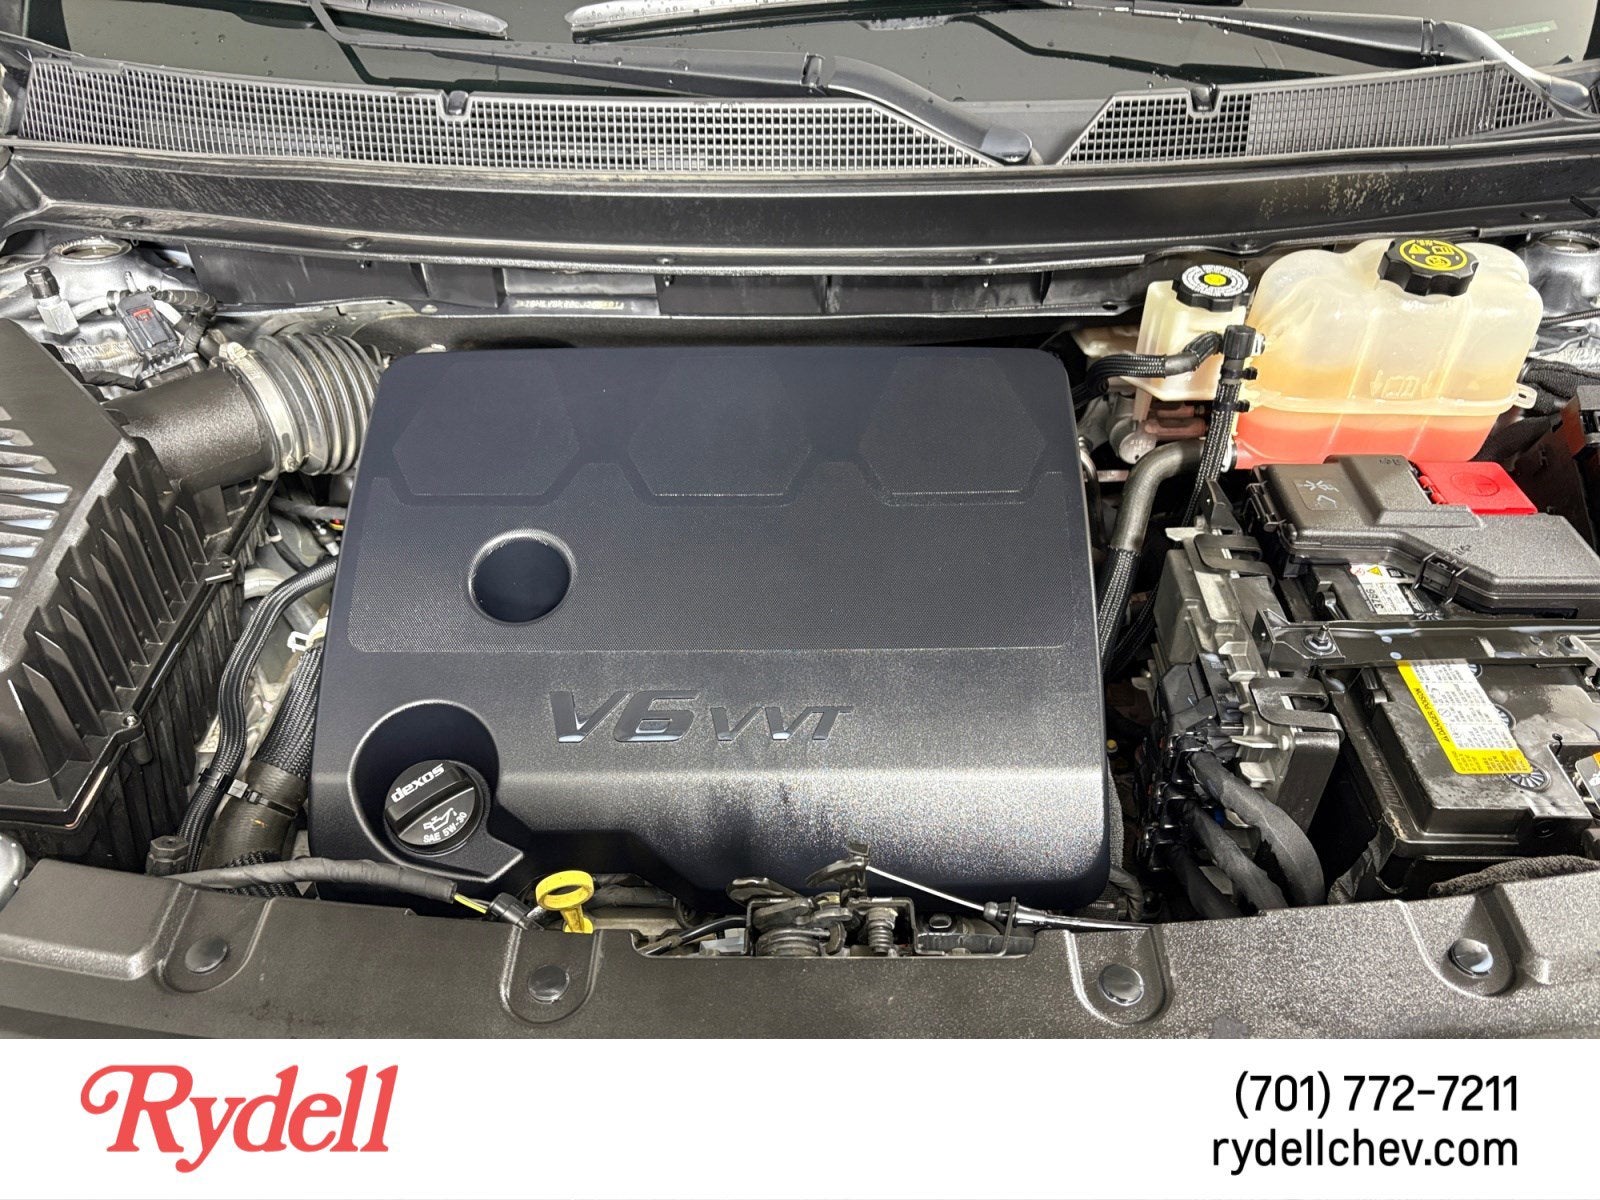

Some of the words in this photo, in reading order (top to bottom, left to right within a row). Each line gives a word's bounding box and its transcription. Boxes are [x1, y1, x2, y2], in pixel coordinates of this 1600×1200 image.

[550, 690, 700, 743] V6
[710, 706, 853, 741] VVT
[391, 763, 445, 803] dexos
[423, 833, 441, 843] SAE
[442, 811, 468, 836] 5W-30
